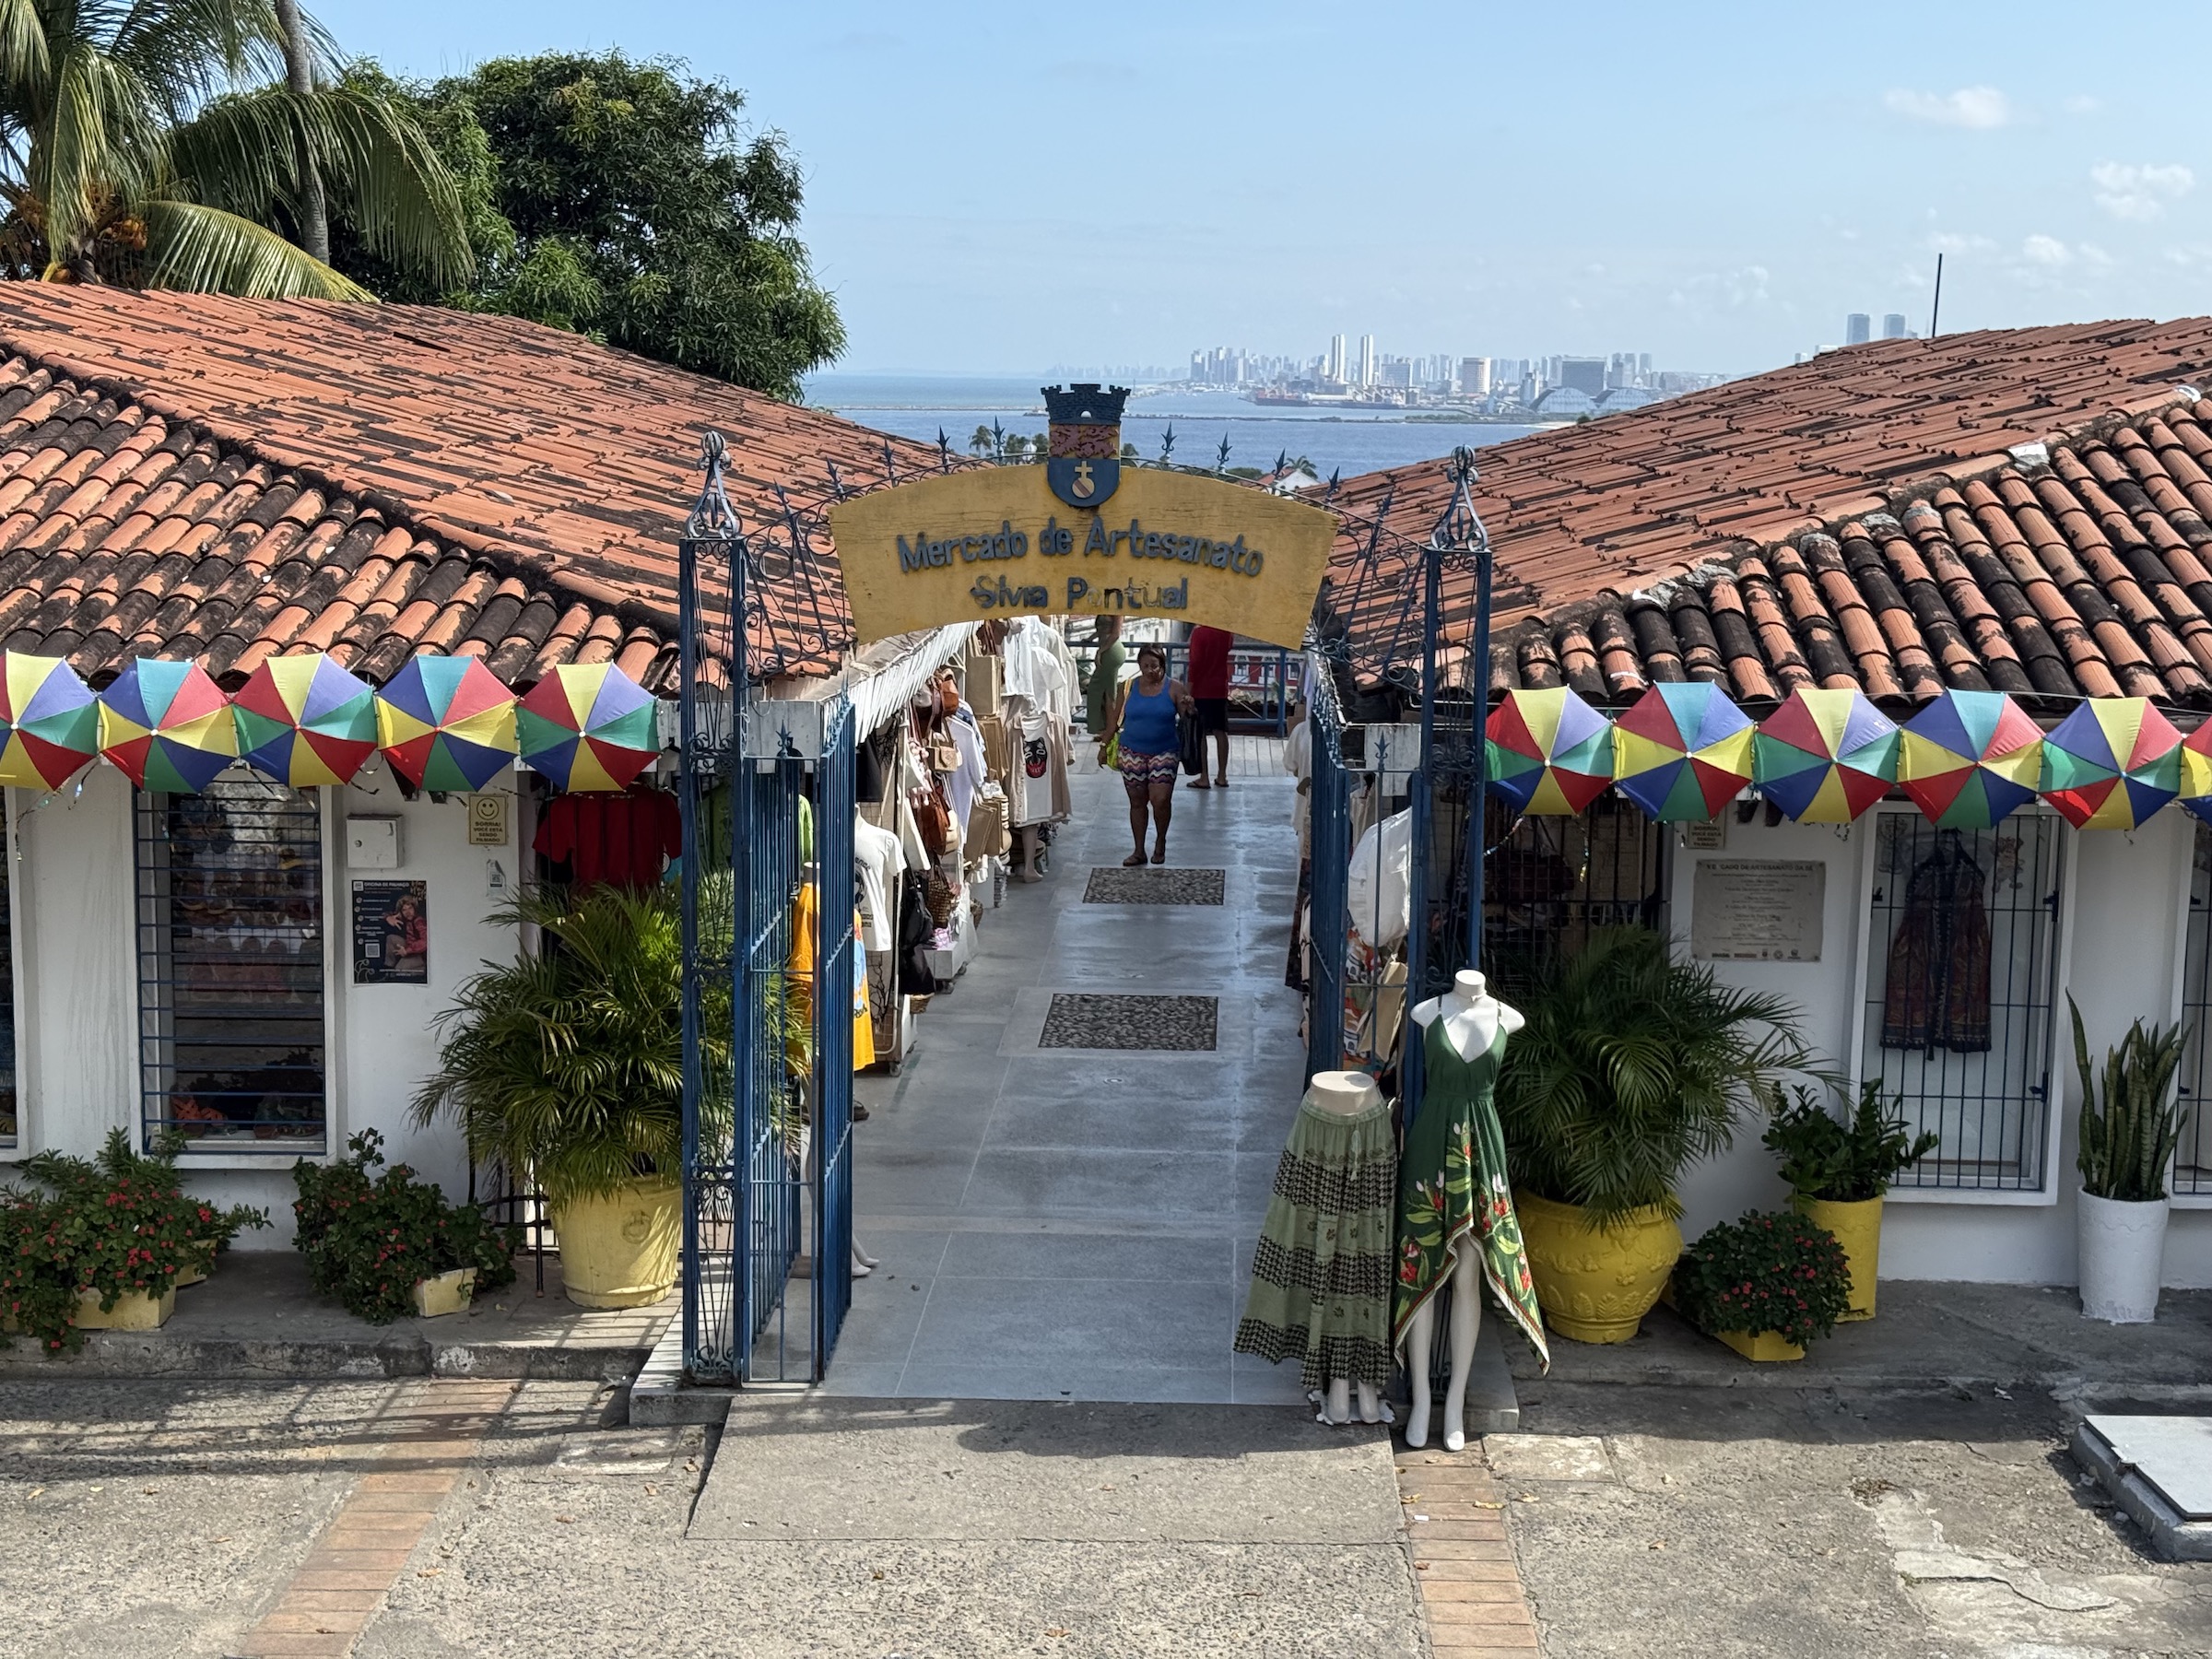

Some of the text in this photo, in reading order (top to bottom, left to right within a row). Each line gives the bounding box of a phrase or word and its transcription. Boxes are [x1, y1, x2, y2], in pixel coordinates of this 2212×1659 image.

[896, 515, 1265, 577] Mercado de Artesanato
